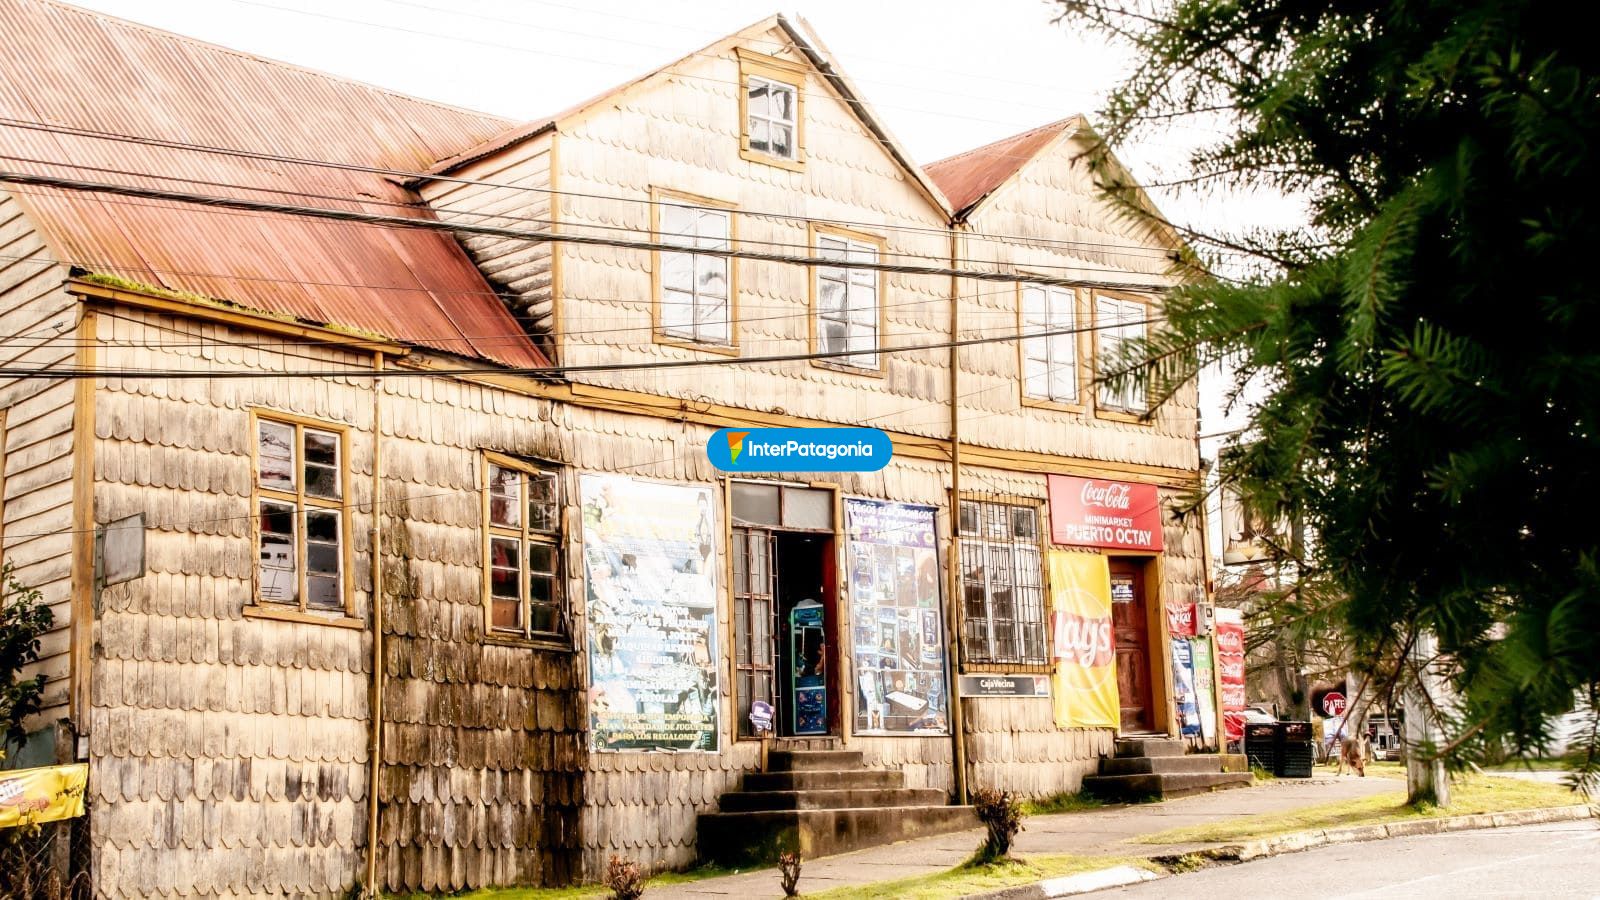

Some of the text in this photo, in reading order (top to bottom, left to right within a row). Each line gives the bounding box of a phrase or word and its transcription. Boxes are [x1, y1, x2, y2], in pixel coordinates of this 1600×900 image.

[1081, 481, 1131, 509] Coca-Cola
[1084, 514, 1133, 527] MINIMARKET
[1065, 523, 1152, 546] PUERTO OCTAY
[635, 654, 674, 665] KIDDIES
[980, 679, 1015, 690] CajaVecina
[635, 693, 679, 703] PISTOLAS
[1324, 699, 1345, 709] PARE
[664, 723, 675, 731] DE
[676, 723, 714, 731] JUGUETES
[612, 732, 700, 741] PARA LOS REGALONES
